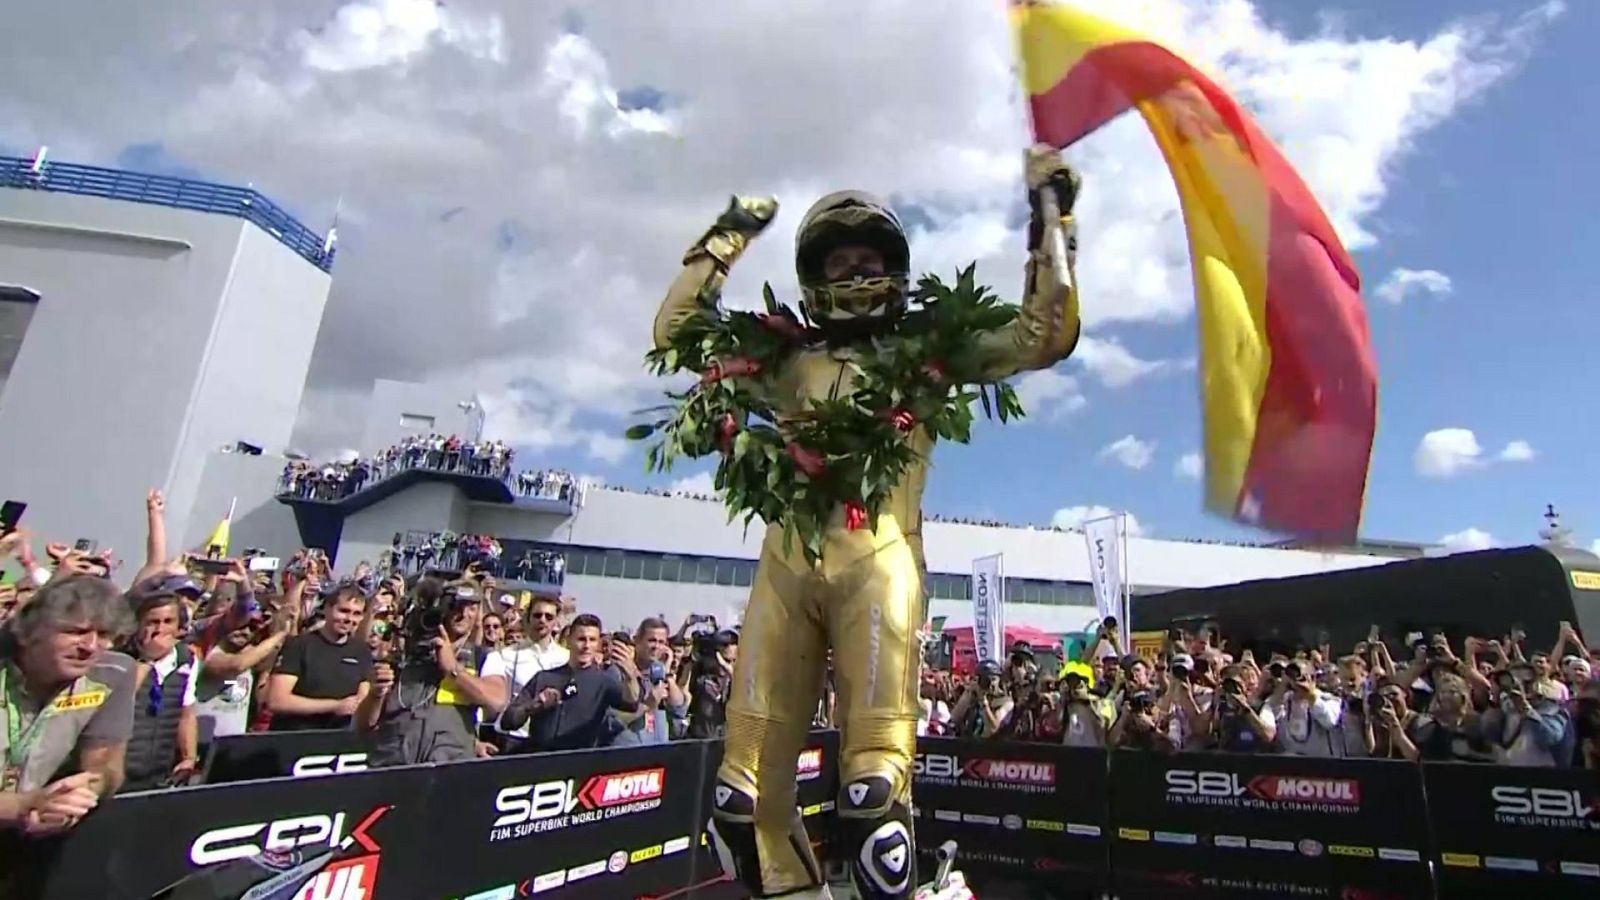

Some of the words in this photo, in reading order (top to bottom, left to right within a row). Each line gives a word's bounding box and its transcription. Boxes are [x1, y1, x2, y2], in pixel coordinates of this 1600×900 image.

[988, 760, 1052, 781] MOTUL
[602, 772, 660, 802] MOTUL
[1276, 778, 1354, 800] MOTUL
[1186, 795, 1240, 807] SUPERBIKE
[1243, 799, 1280, 810] WORLD
[1282, 801, 1361, 814] CHAMPIONSHIP
[490, 826, 511, 842] FIM
[514, 815, 569, 838] SUPERBIKE
[572, 809, 602, 825] WORLD
[604, 798, 662, 819] CHAMPIONSHIP
